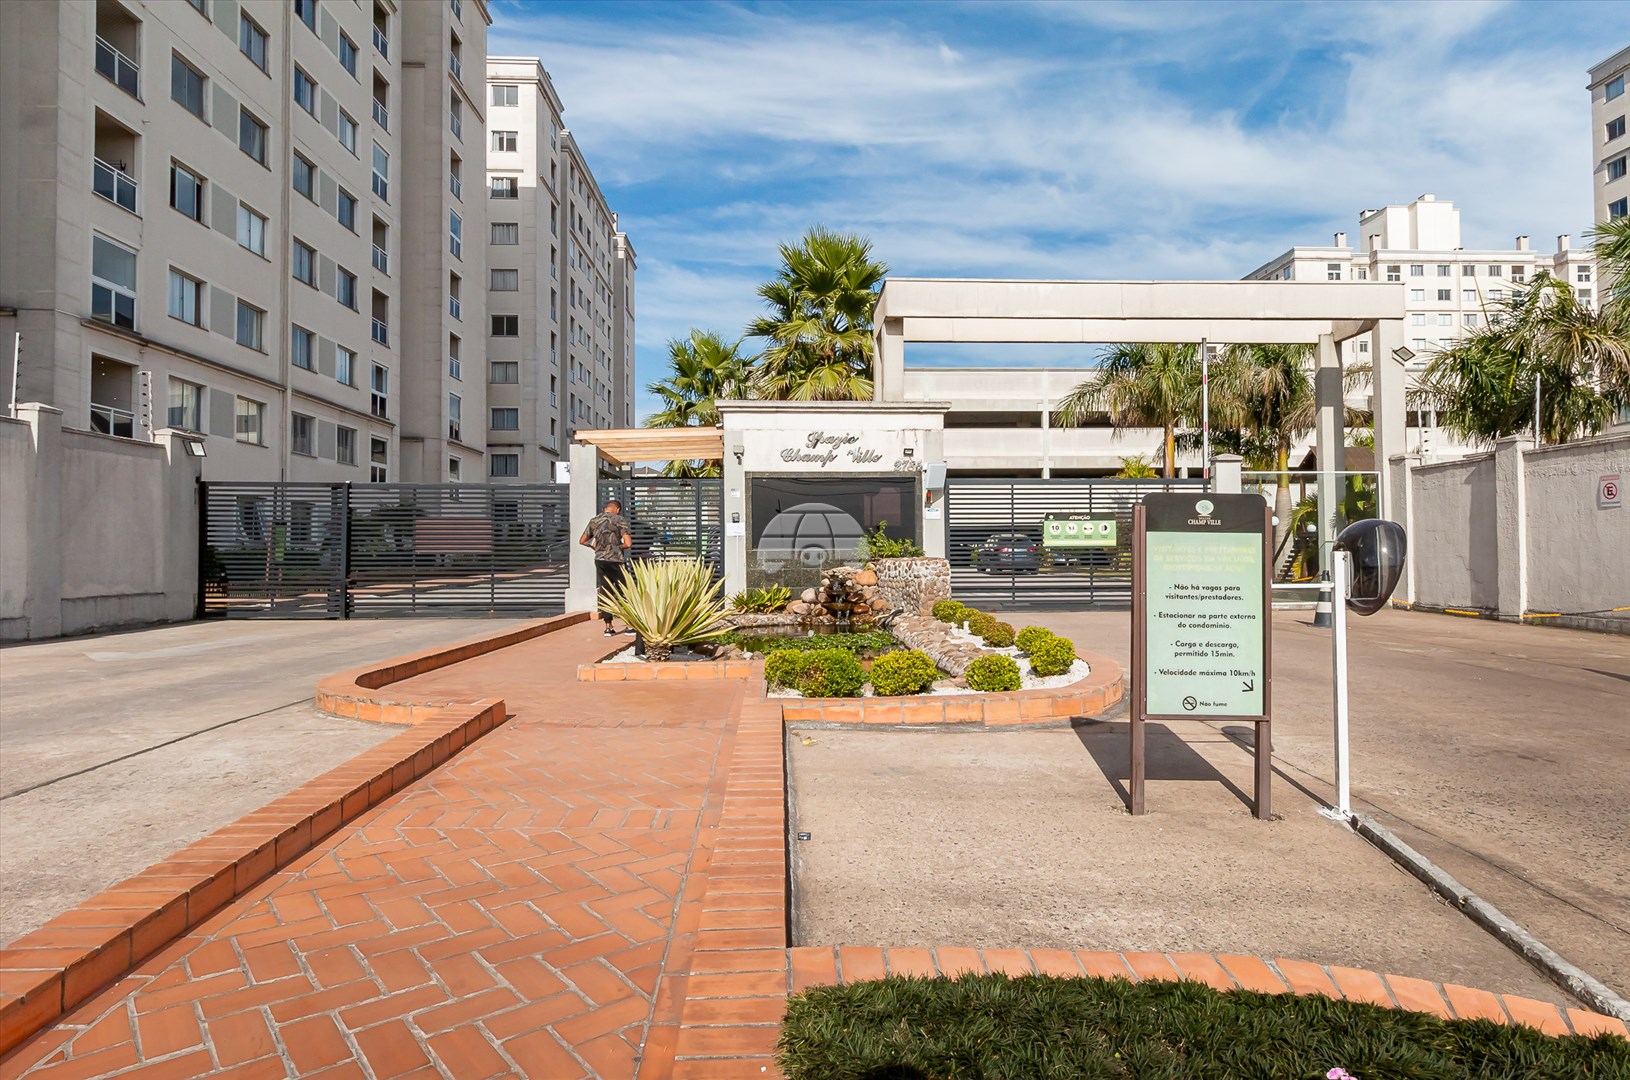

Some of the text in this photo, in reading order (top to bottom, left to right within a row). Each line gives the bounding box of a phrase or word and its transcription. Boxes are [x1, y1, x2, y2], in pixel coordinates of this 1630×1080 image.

[780, 447, 883, 468] Champ Ville
[1158, 611, 1195, 619] Estacionar
[1175, 640, 1197, 649] Carga
[1205, 641, 1239, 649] descarga,
[1174, 650, 1208, 658] permitido
[1199, 669, 1227, 677] máxima
[1229, 669, 1256, 677] 10km/h
